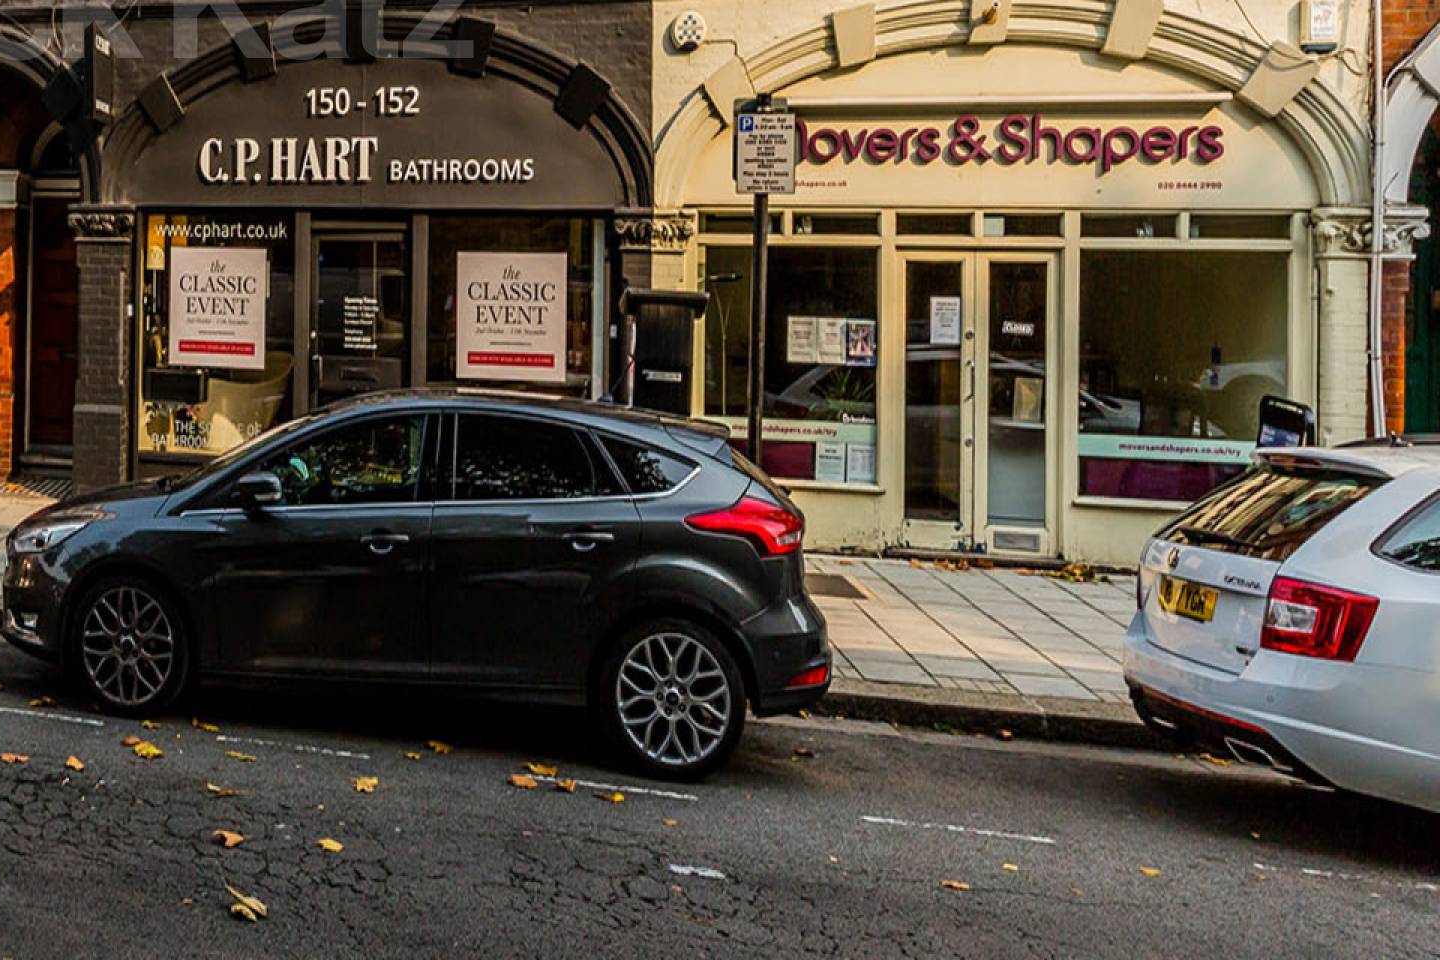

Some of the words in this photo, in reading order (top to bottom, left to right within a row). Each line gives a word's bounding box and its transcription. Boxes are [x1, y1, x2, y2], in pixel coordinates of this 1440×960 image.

[307, 87, 350, 116] 150
[375, 86, 421, 115] 152
[949, 114, 992, 161] &
[999, 112, 1225, 174] Shapers
[389, 158, 535, 182] BATHROOMS
[155, 221, 288, 243] www.cphart.co.uk
[210, 259, 226, 273] the
[502, 264, 521, 280] the
[179, 273, 257, 294] CLASSIC
[467, 282, 556, 303] CLASSIC
[186, 297, 250, 315] EVENT
[476, 305, 548, 325] EVENT
[175, 420, 196, 434] THE
